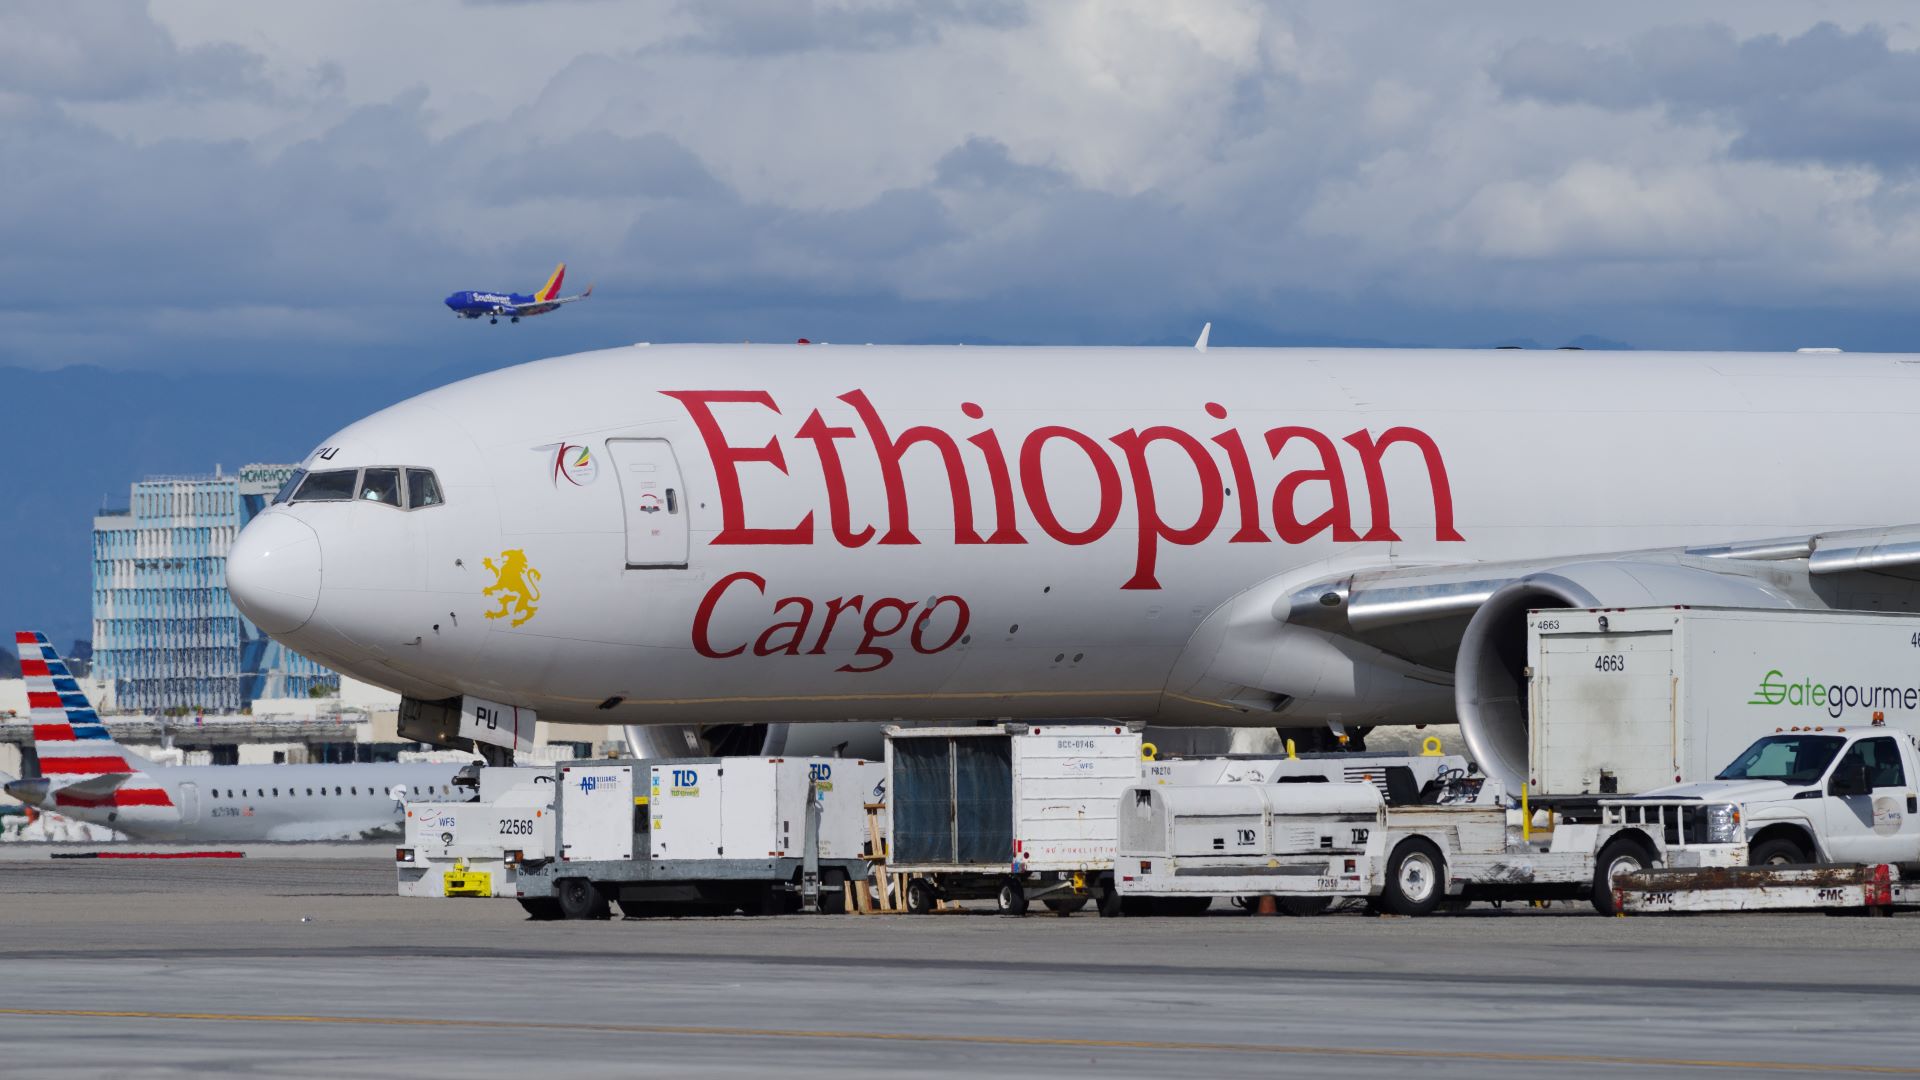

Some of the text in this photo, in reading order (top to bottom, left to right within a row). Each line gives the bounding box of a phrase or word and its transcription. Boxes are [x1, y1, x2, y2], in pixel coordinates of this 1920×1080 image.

[240, 468, 297, 482] HOMEWOO
[657, 388, 1465, 590] Ethiopian
[691, 571, 970, 673] Cargo
[1537, 620, 1560, 630] 4663
[1595, 655, 1625, 671] 4663
[475, 706, 499, 730] PU
[809, 764, 831, 780] TLD
[1079, 762, 1094, 770] WFS
[580, 776, 596, 795] AGI
[672, 770, 698, 787] TLD
[439, 817, 455, 827] WFS
[499, 819, 533, 835] 22568
[1818, 889, 1844, 901] FMC
